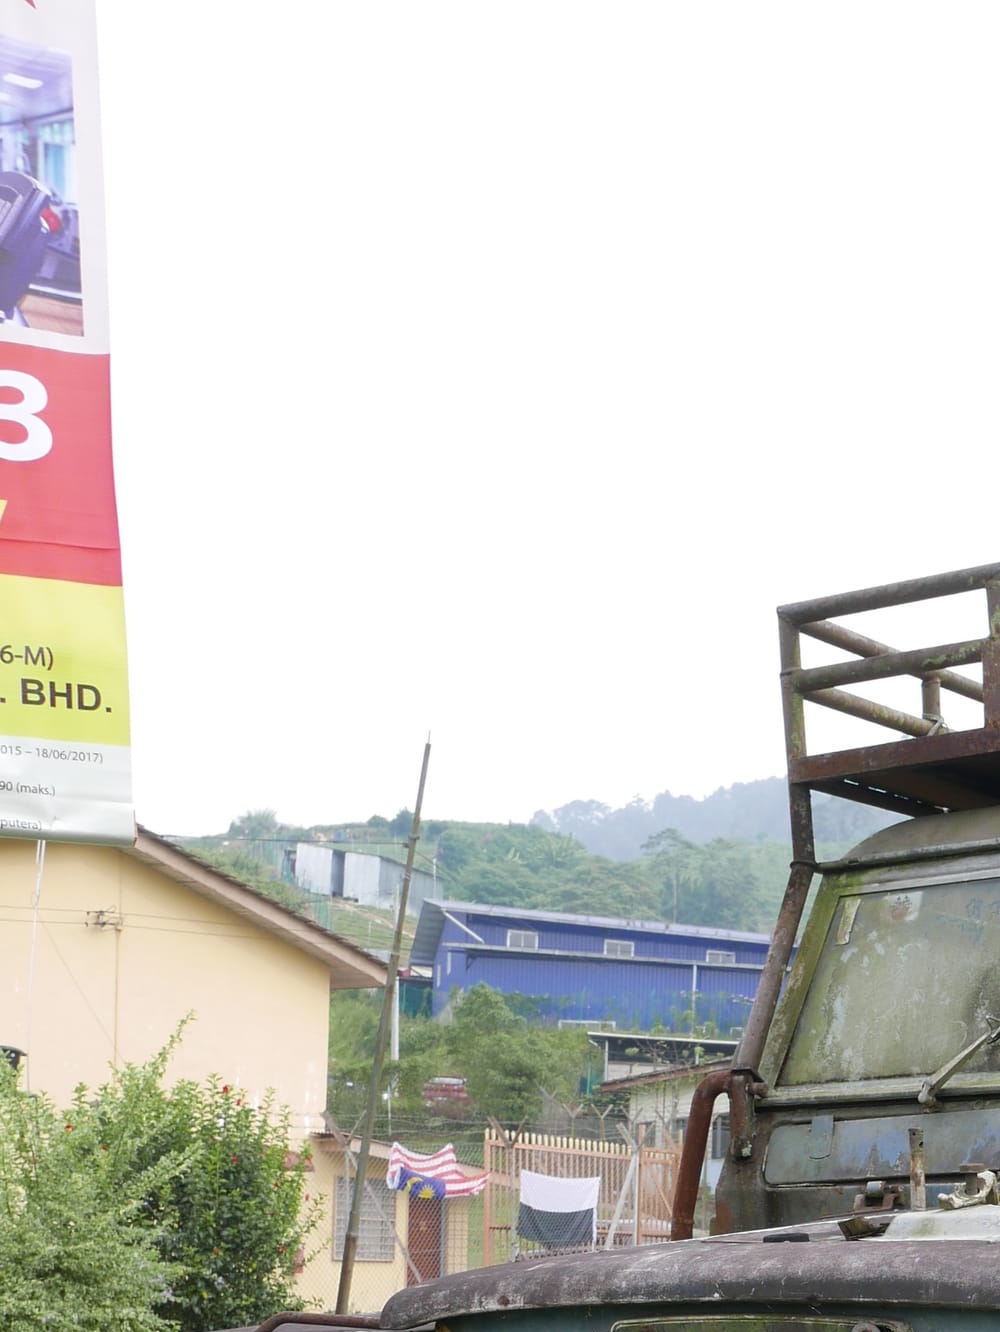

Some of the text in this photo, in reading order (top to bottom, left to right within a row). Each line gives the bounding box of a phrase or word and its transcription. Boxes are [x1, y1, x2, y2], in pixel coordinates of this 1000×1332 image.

[21, 678, 112, 713] BHD.
[36, 747, 104, 764] 18/06/2017)
[16, 782, 56, 797] (maks.)
